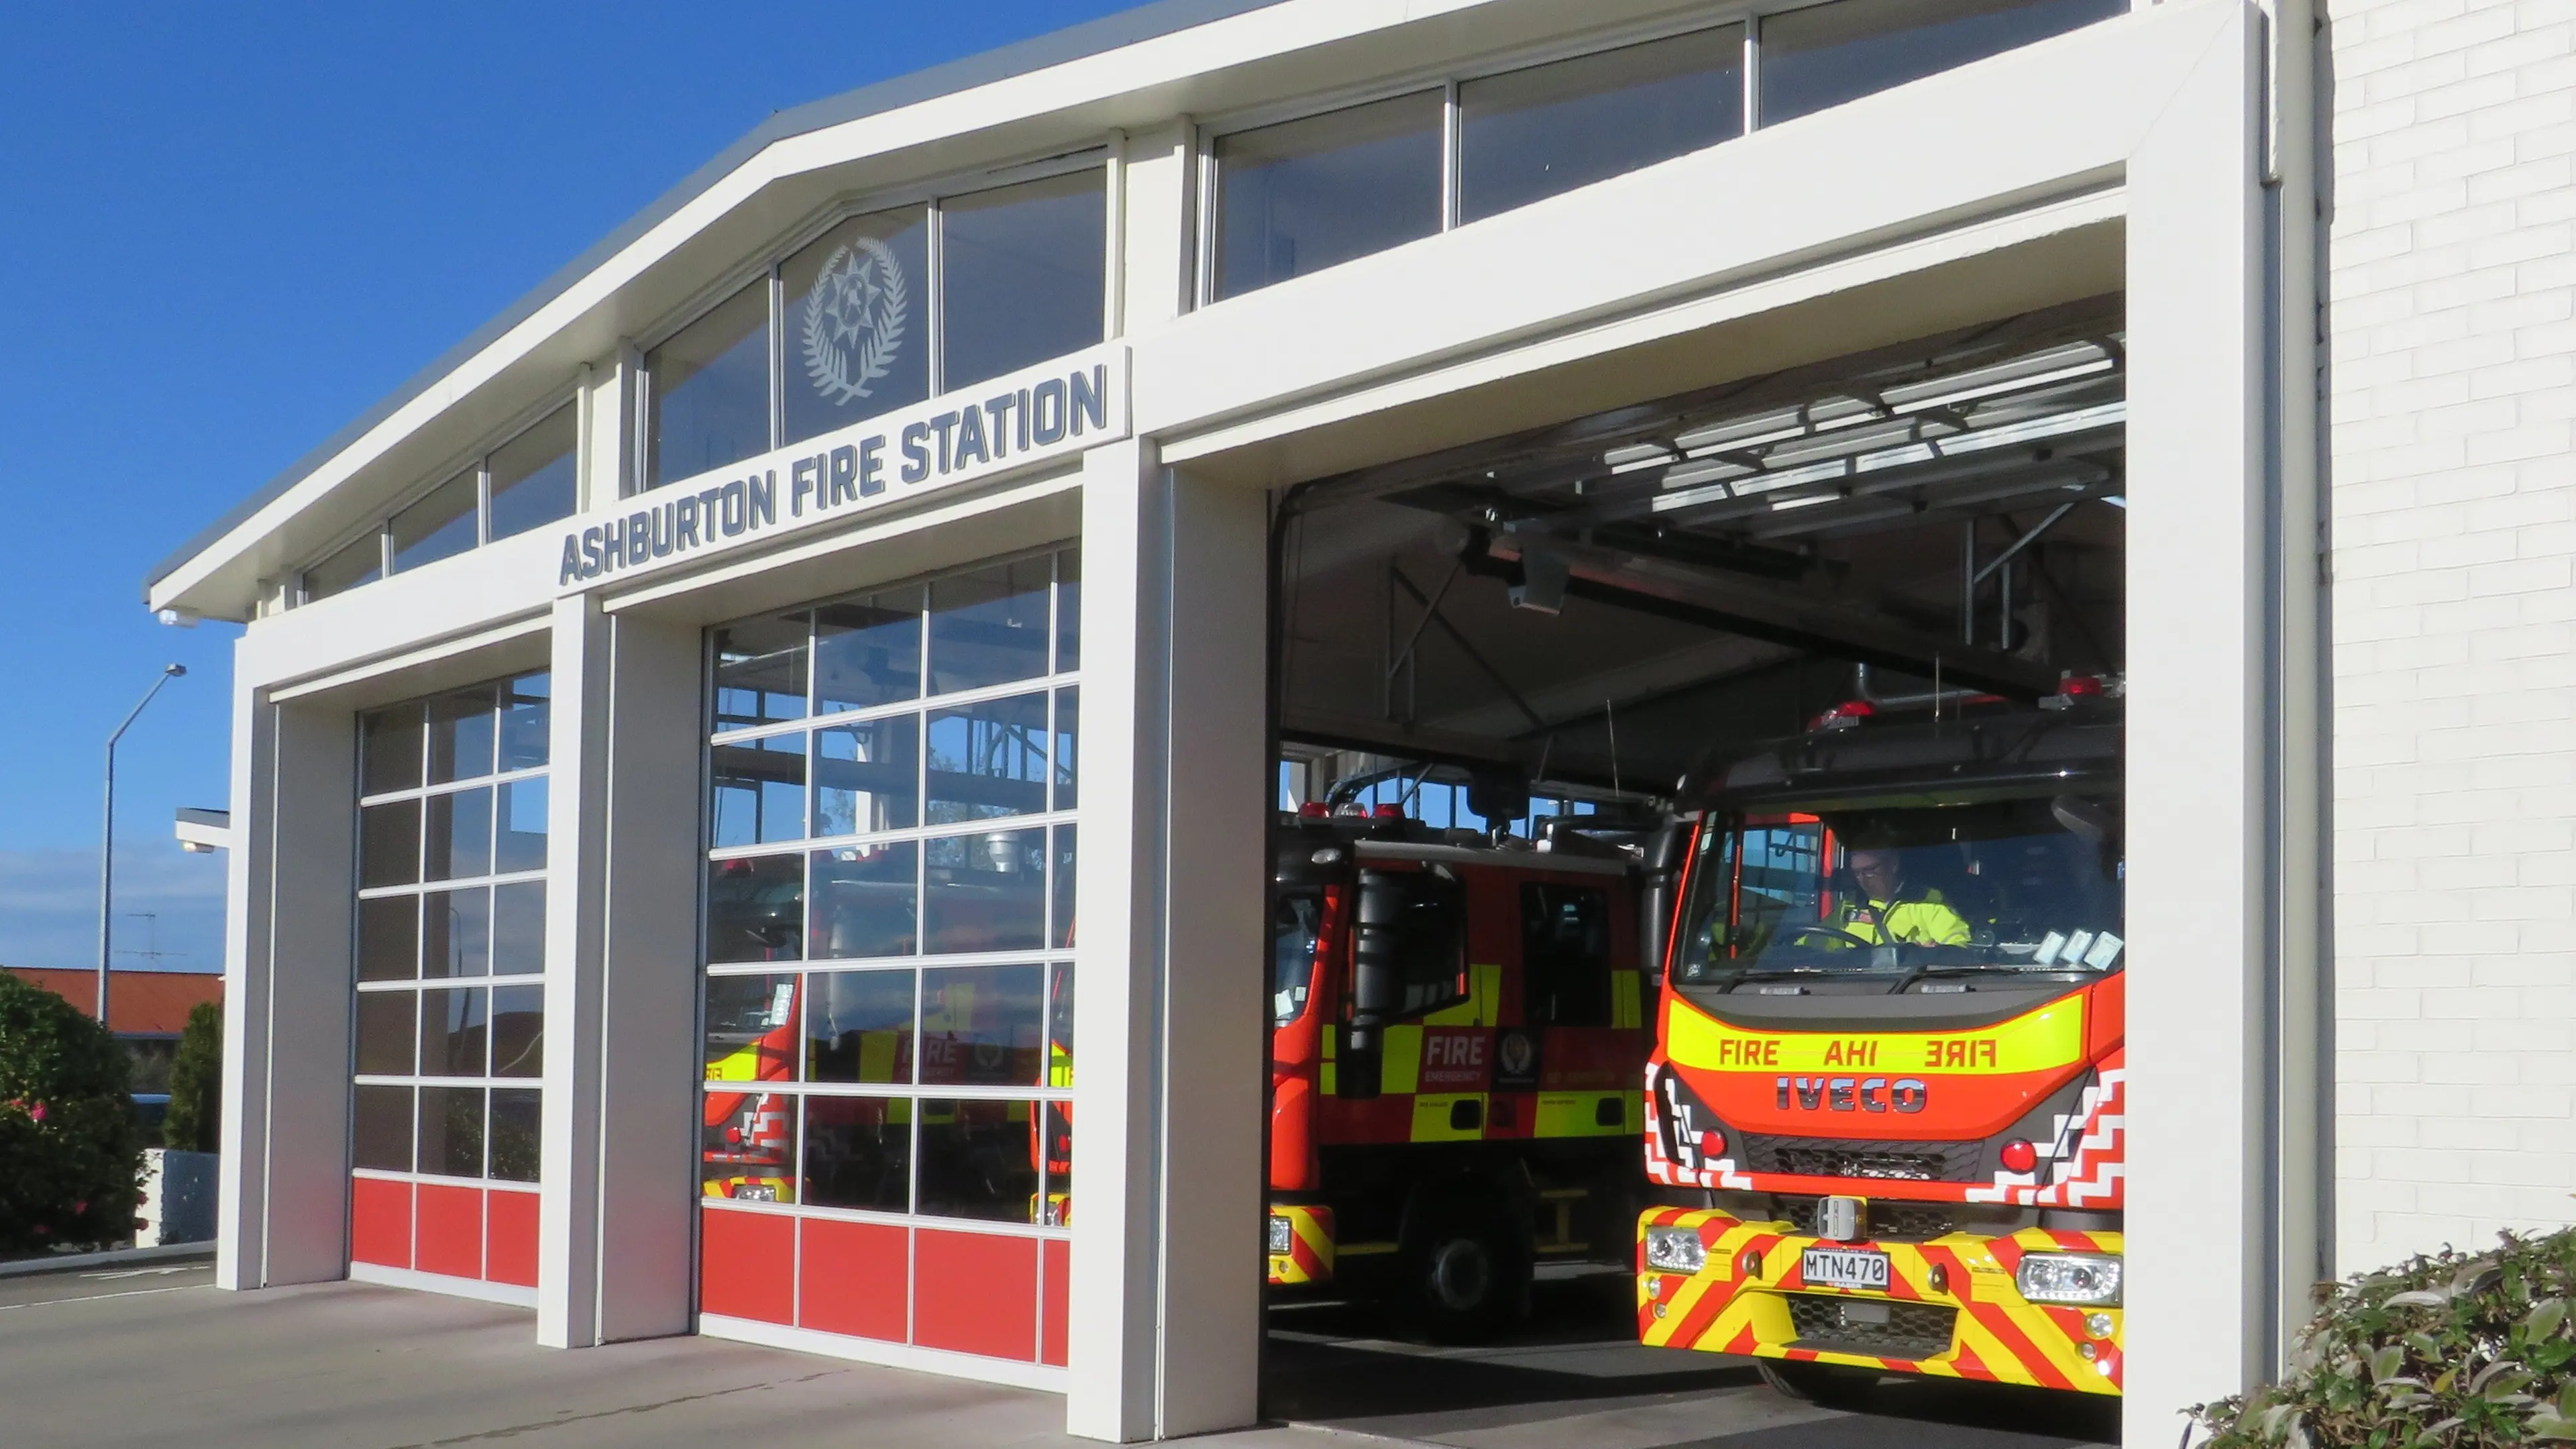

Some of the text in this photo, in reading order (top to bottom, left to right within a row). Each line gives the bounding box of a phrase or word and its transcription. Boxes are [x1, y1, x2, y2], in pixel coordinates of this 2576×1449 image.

[559, 363, 1107, 585] ASHBURTON FIRE STATION
[1426, 1036, 1485, 1065] FIRE
[1719, 1039, 1878, 1066] FIRE AHI
[1425, 1071, 1481, 1082] EMERGENCY
[1776, 1075, 1928, 1113] IVECO
[1806, 1254, 1884, 1282] MTN470
